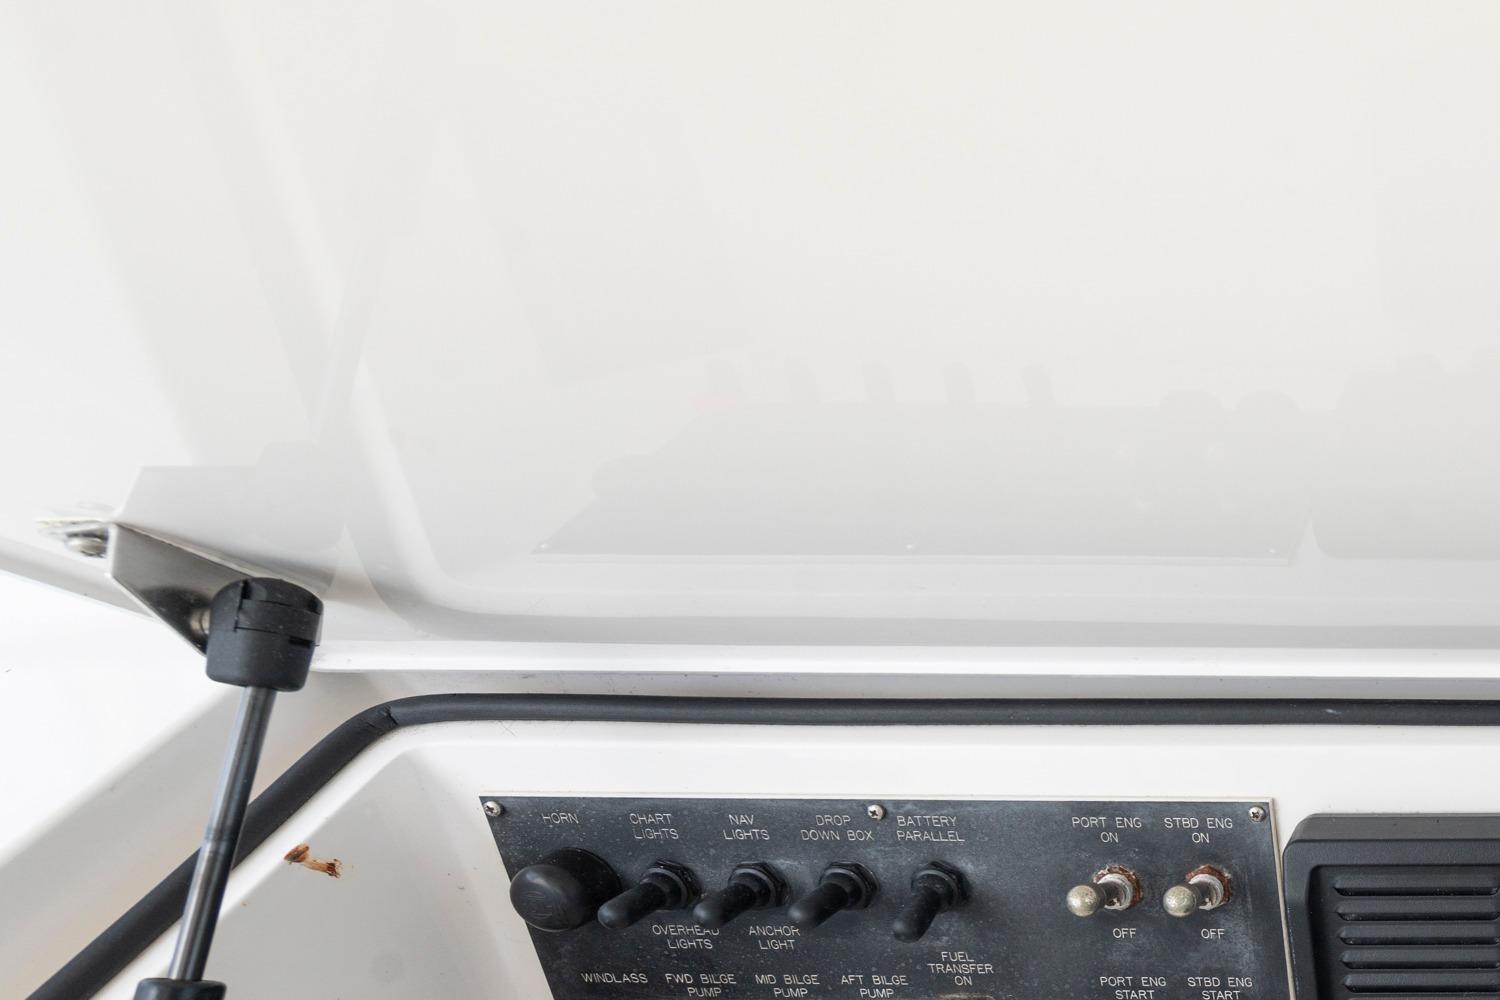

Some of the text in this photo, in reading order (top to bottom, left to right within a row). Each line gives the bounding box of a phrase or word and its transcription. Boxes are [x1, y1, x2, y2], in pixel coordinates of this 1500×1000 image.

[542, 813, 579, 824] HORN
[629, 813, 672, 825] CHART
[728, 814, 754, 825] NAV
[816, 815, 851, 826] DROP
[896, 815, 957, 827] BATTERY
[1072, 817, 1142, 828] PORT ENG
[1164, 817, 1233, 829] STBD ENG
[634, 828, 679, 840] LIGHTS
[723, 829, 769, 841] LIGHTS
[801, 829, 874, 841] DOWN BOX
[896, 830, 965, 842] PARALLEL
[1100, 832, 1119, 843] ON
[1191, 832, 1210, 844] ON
[749, 926, 800, 936] ANCHOR
[1112, 928, 1137, 939] OFF
[1200, 928, 1225, 939] OFF
[667, 939, 713, 949] LIGHTS
[758, 939, 795, 950] LIGHT
[941, 952, 975, 962] FUEL
[927, 964, 994, 975] TRANSFER
[581, 973, 648, 984] WINDLASS
[665, 973, 736, 984] FWD BILGE
[755, 974, 820, 985] MID BILGE
[841, 975, 908, 986] AFT BILGE
[954, 976, 972, 986] ON
[1100, 976, 1167, 987] PORT ENG
[1187, 977, 1253, 987] STBD ENG
[687, 987, 722, 998] PUMP
[773, 988, 808, 998] PUMP
[859, 988, 894, 999] PUMP
[1115, 989, 1154, 1000] START
[1202, 990, 1240, 1000] START
